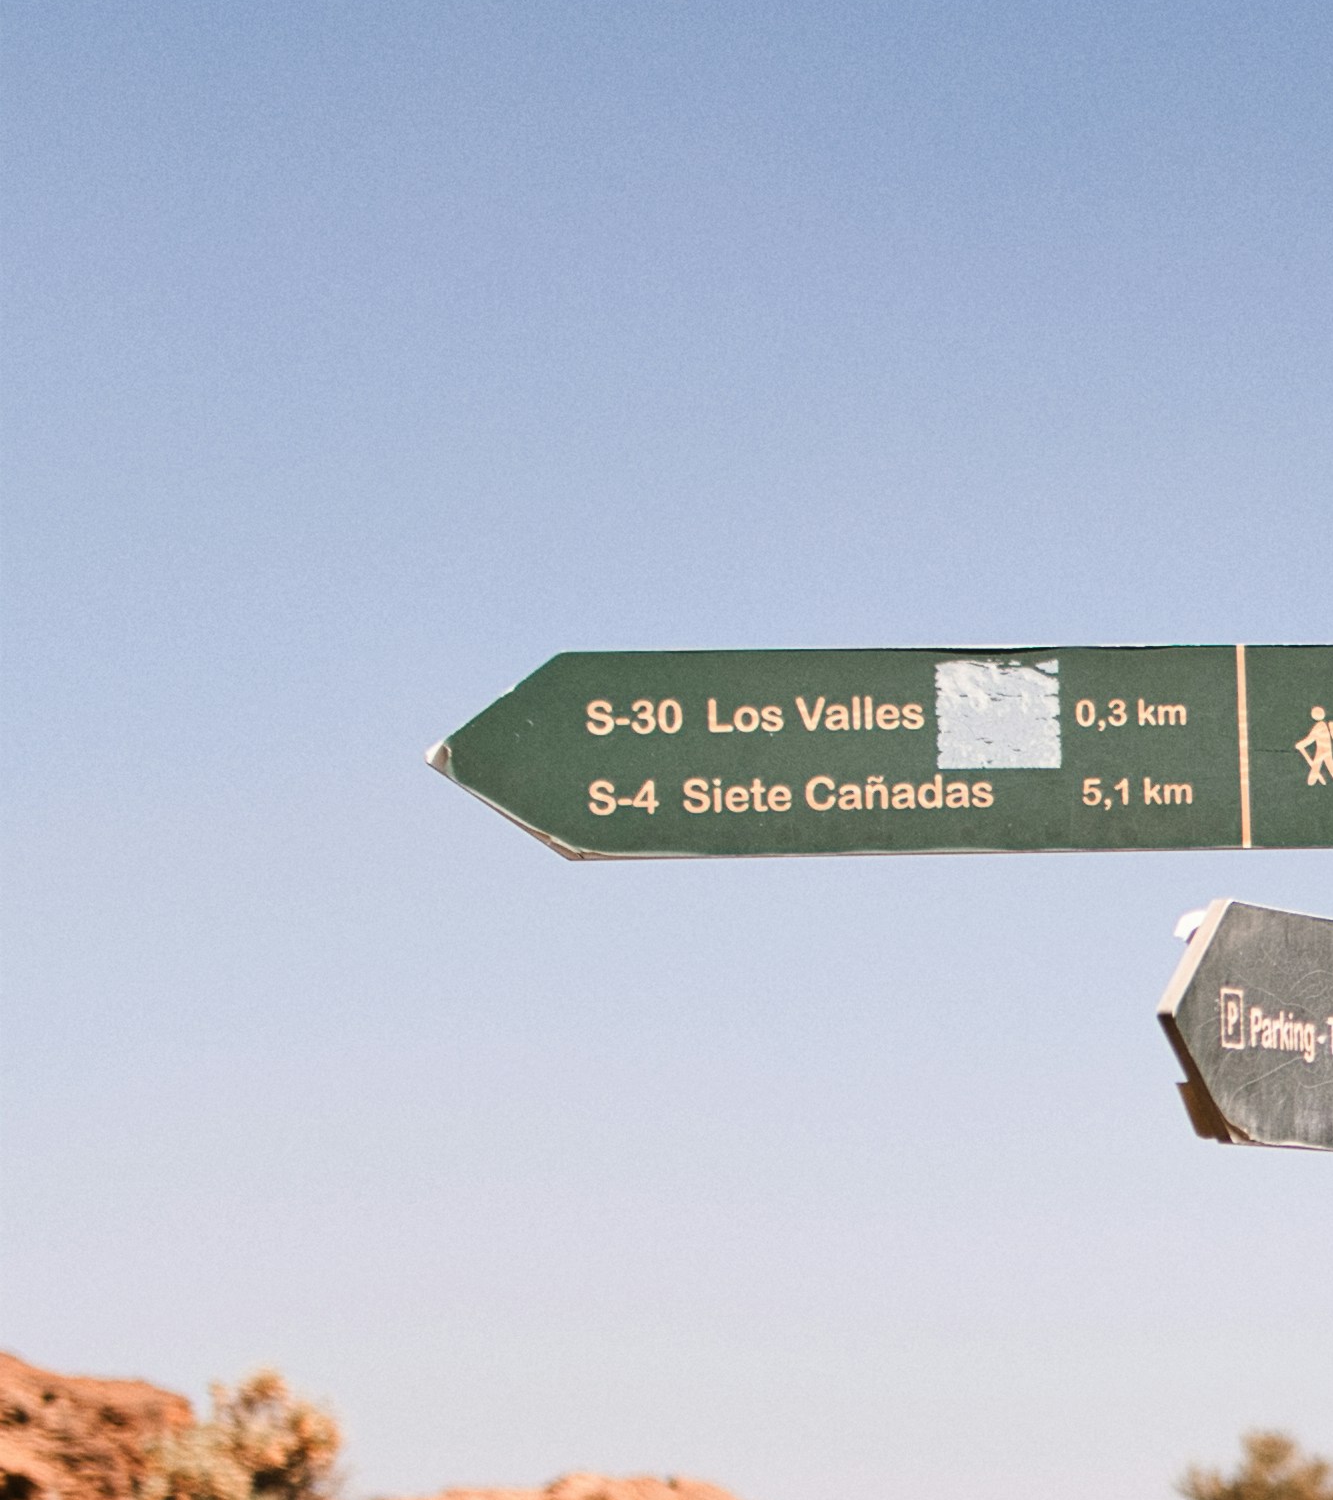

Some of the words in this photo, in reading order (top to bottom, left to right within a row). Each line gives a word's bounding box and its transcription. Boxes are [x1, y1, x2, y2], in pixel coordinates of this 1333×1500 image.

[586, 699, 683, 735] S-30
[707, 697, 785, 733] Los
[795, 696, 926, 731] Valles
[1074, 698, 1128, 732] 0,3
[1137, 698, 1188, 727] km
[588, 779, 660, 816] S-4
[682, 777, 793, 814] Siete
[804, 773, 995, 812] Cañadas
[1081, 777, 1131, 811] 5,1
[1143, 776, 1194, 806] km
[1249, 1007, 1316, 1064] Parking
